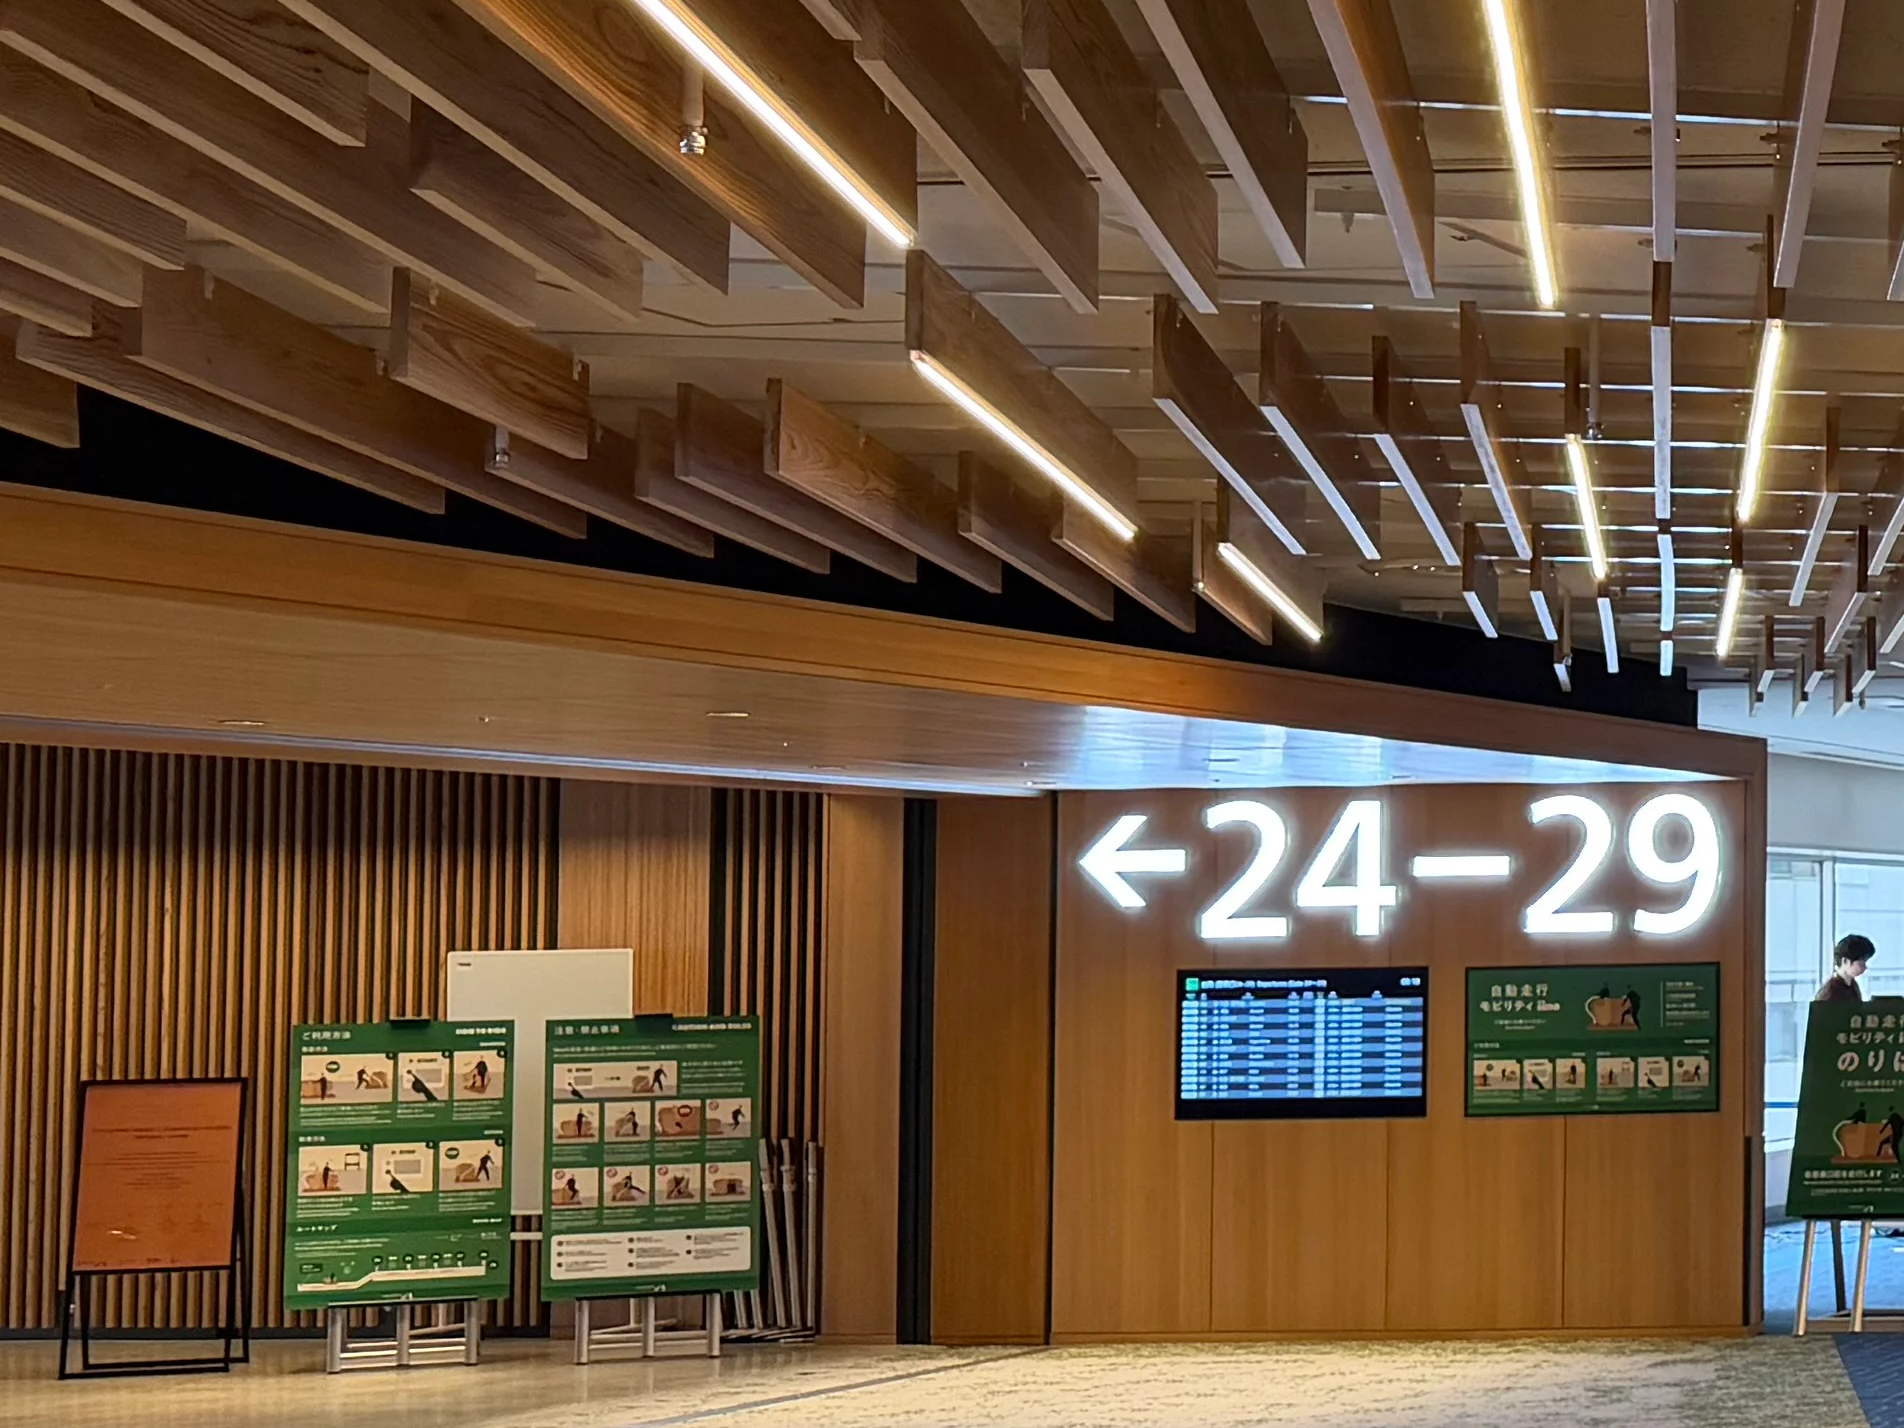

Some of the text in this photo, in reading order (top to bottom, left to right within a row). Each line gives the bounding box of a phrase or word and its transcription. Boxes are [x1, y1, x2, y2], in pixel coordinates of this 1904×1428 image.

[1836, 1031, 1895, 1044] モビリティ
